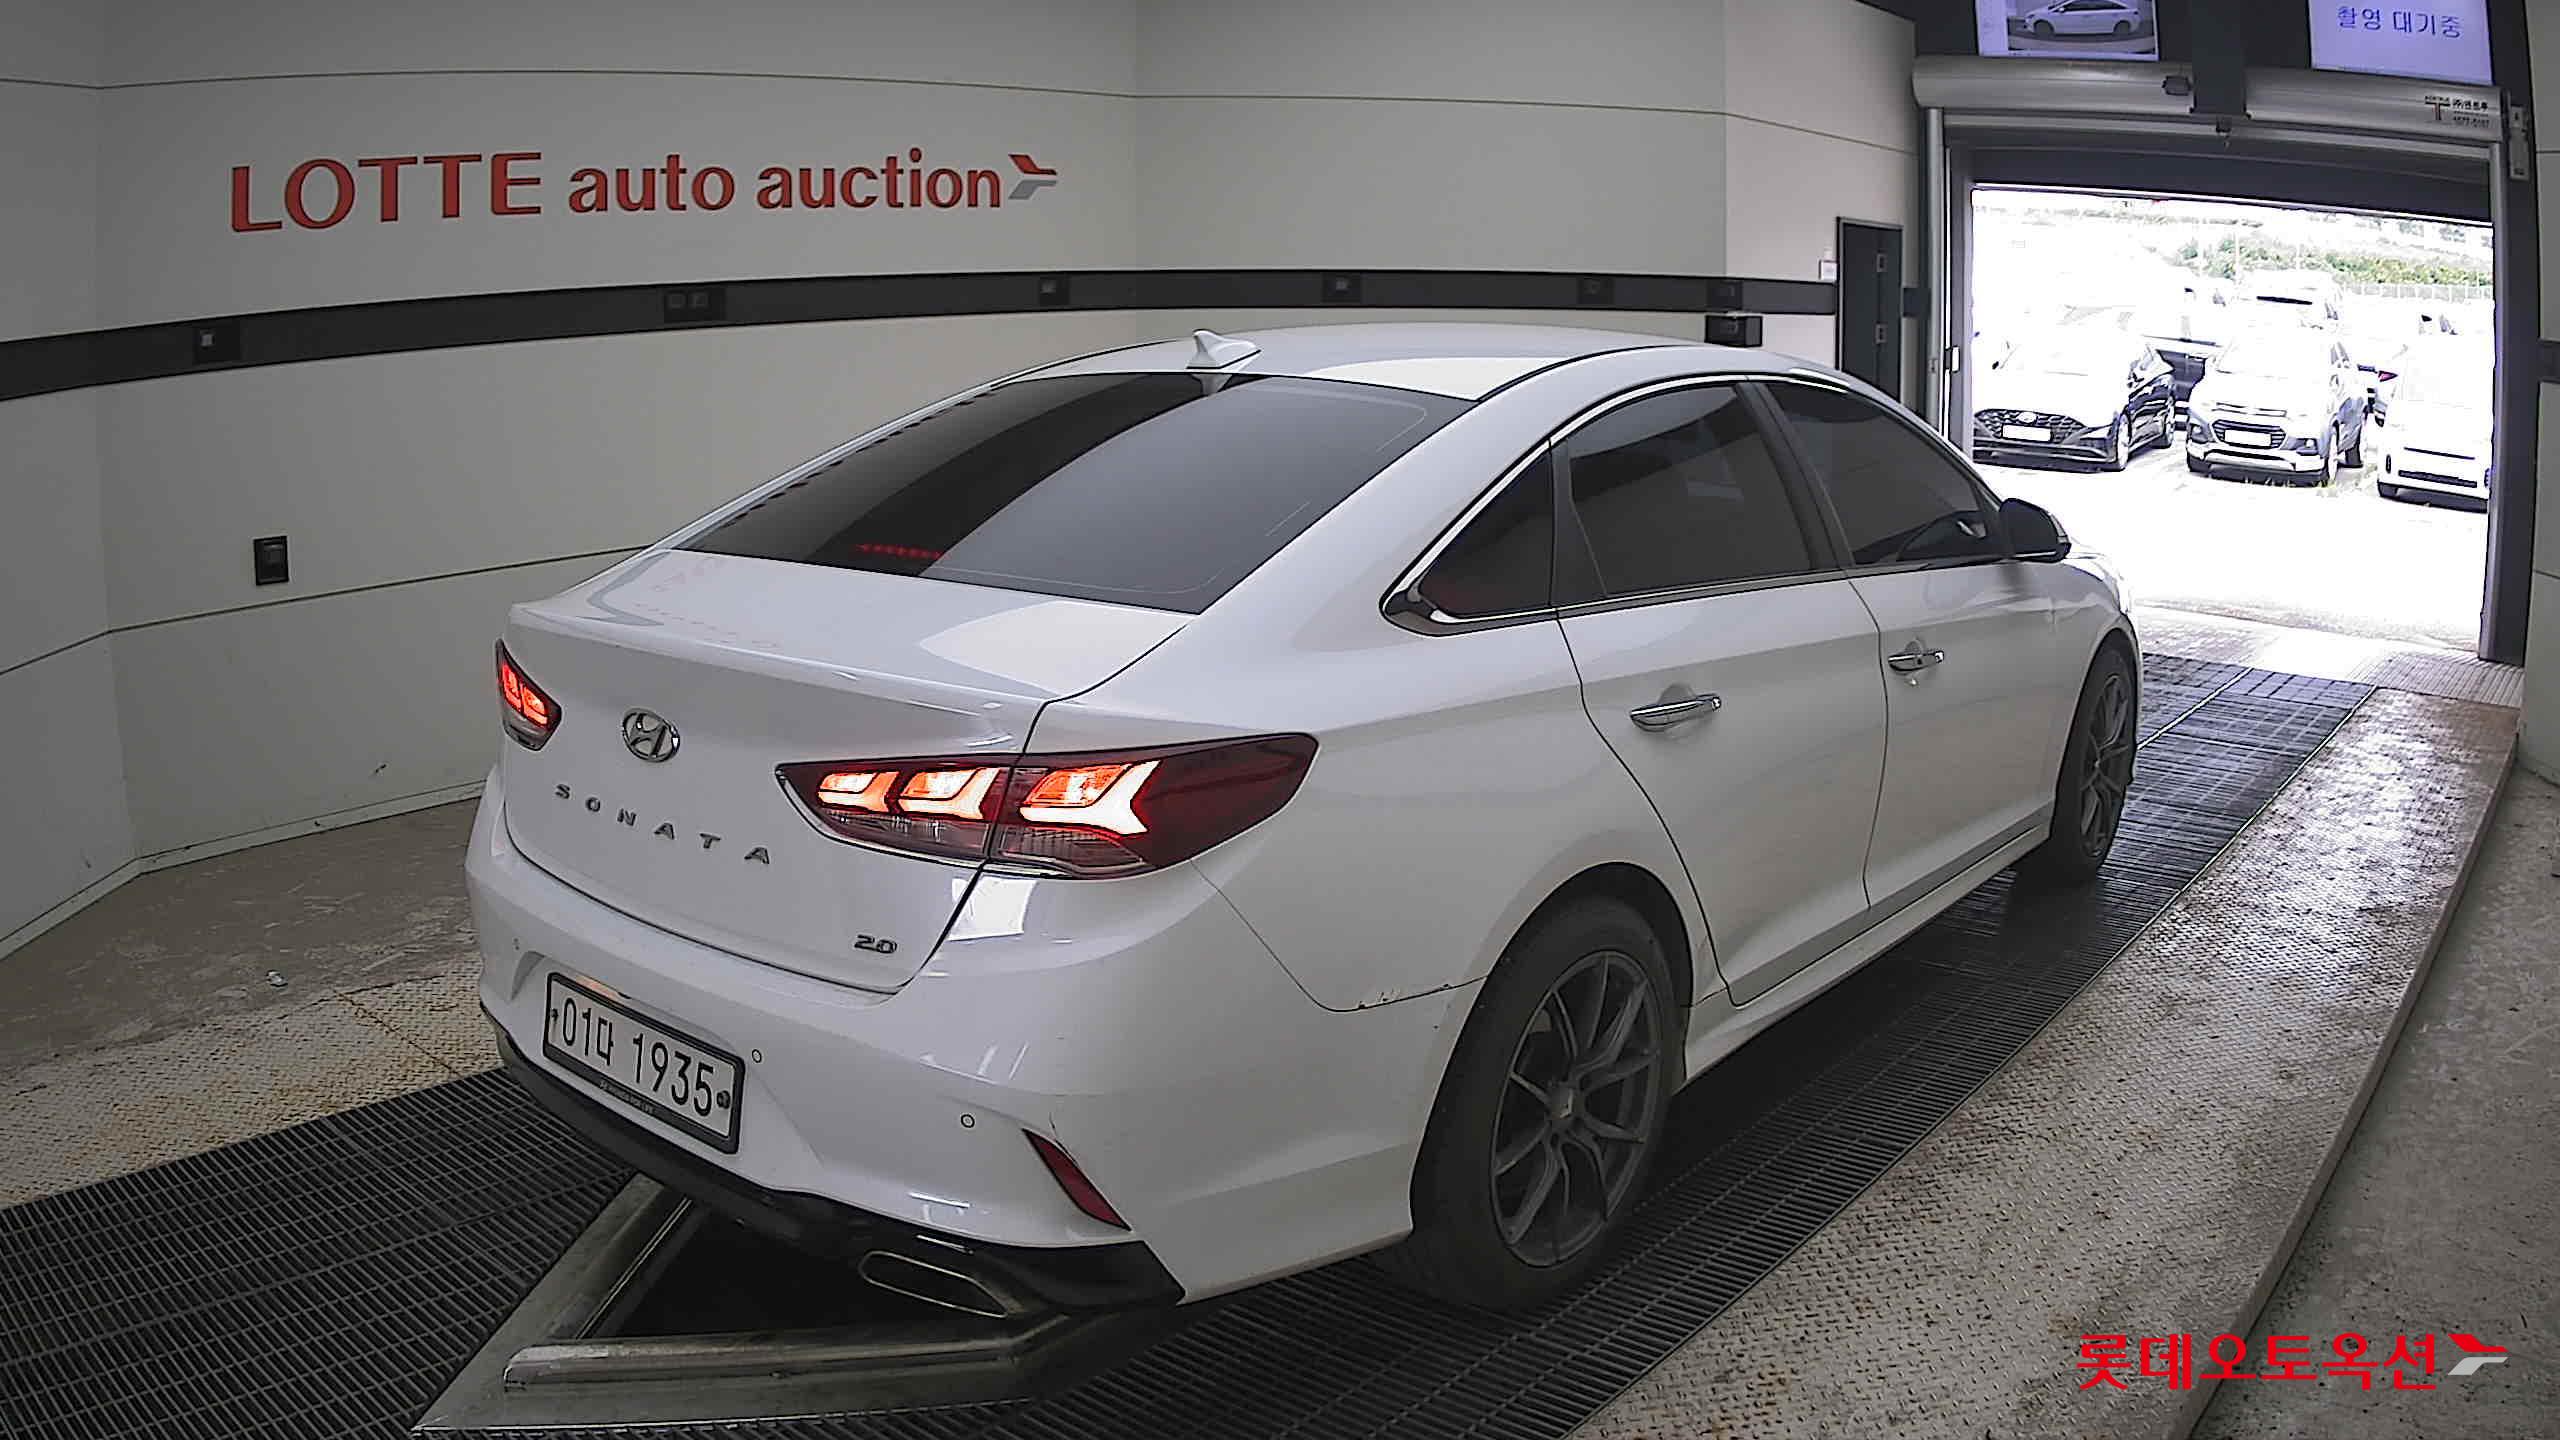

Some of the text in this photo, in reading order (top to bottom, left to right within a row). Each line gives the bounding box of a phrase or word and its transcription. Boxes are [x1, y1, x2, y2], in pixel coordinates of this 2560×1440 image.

[2338, 6, 2461, 38] 촬영 대기중
[230, 147, 1003, 233] LOTTE auto auction
[555, 783, 770, 865] SONATA
[562, 997, 614, 1066] 01다
[632, 1033, 714, 1117] 1935
